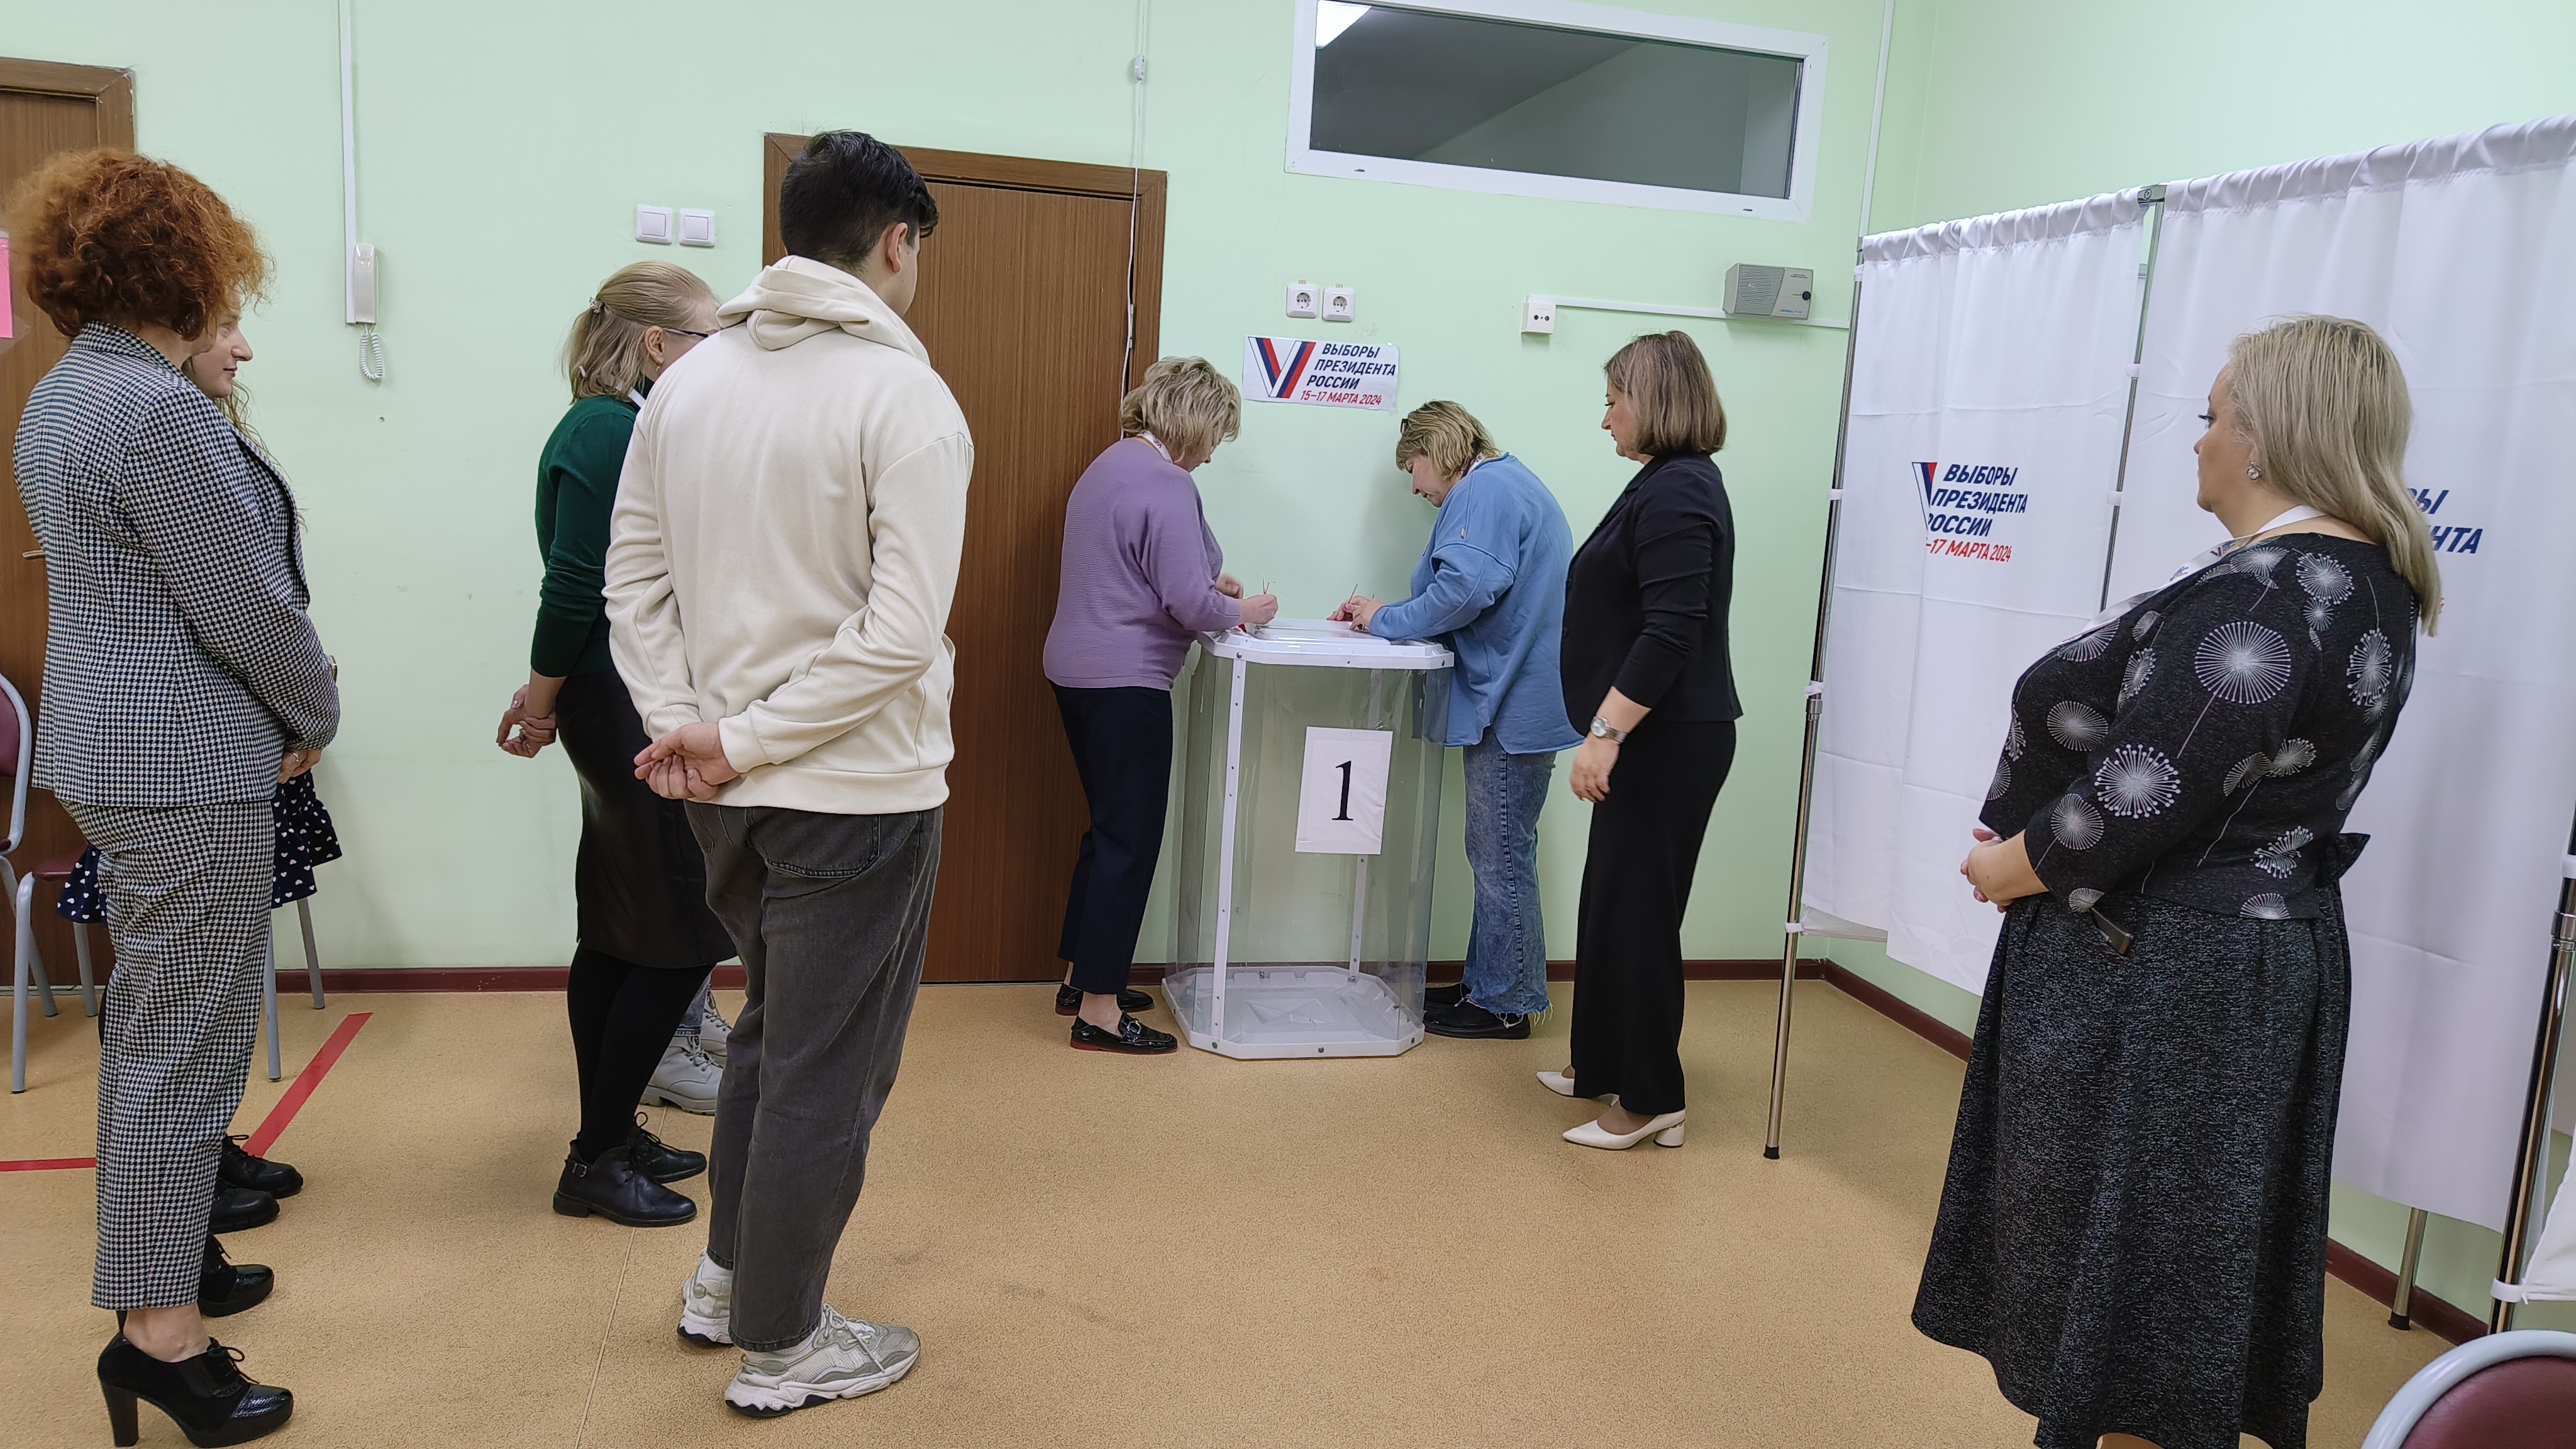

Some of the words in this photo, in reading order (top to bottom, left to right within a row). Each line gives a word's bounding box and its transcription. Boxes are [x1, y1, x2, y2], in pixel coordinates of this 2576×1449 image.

[1322, 343, 1380, 358] ВЫБОРЫ
[1314, 359, 1396, 376] ПРЕЗИДЕНТА
[1306, 375, 1360, 389] РОССИИ
[1327, 392, 1358, 404] МАРТА
[1358, 394, 1382, 406] 2024
[1943, 464, 2018, 486] ВЫБОРЫ
[1931, 488, 2028, 514] ПРЕЗИДЕНТА
[1945, 540, 1990, 560] МАРТА
[1989, 545, 2012, 562] 2024
[1331, 760, 1353, 821] 1
